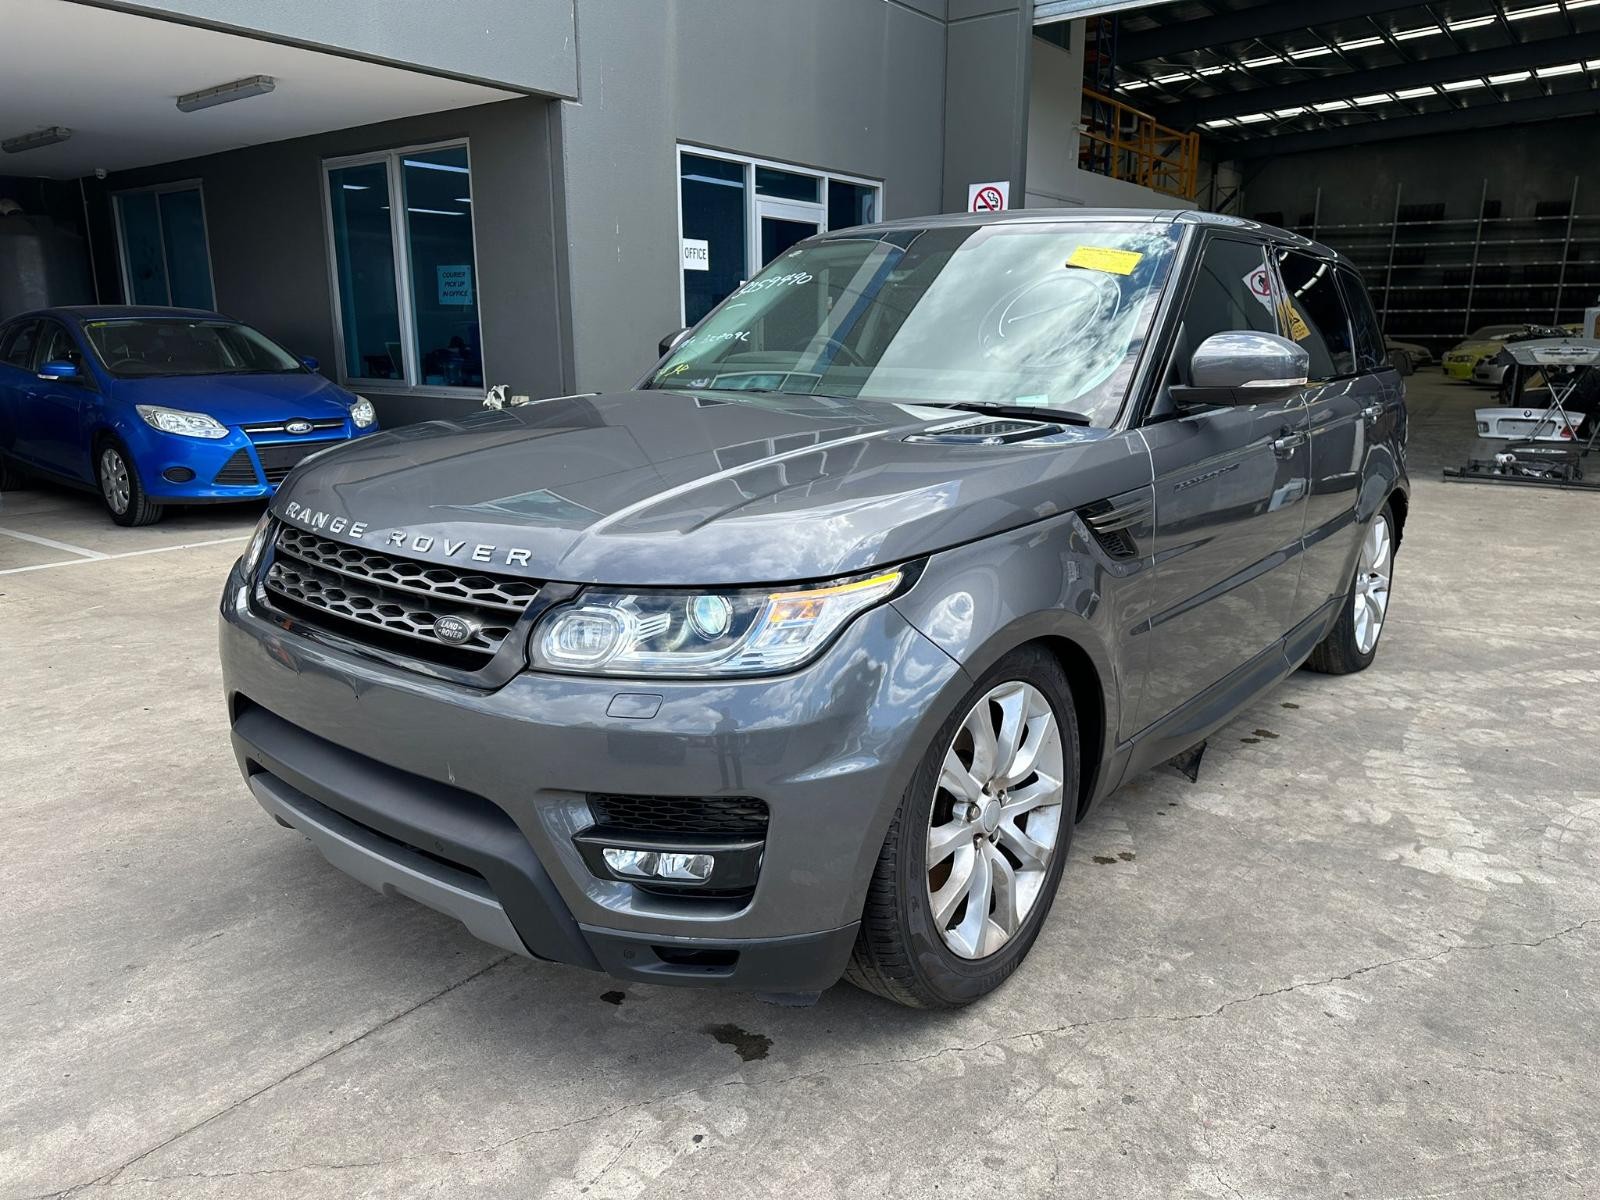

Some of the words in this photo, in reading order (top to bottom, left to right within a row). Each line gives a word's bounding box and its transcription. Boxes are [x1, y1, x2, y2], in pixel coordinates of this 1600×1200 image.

[685, 247, 706, 260] OFFICE
[285, 501, 369, 539] RANGE
[385, 530, 532, 567] ROVER
[440, 620, 459, 630] LAND
[441, 627, 463, 639] ROVER
